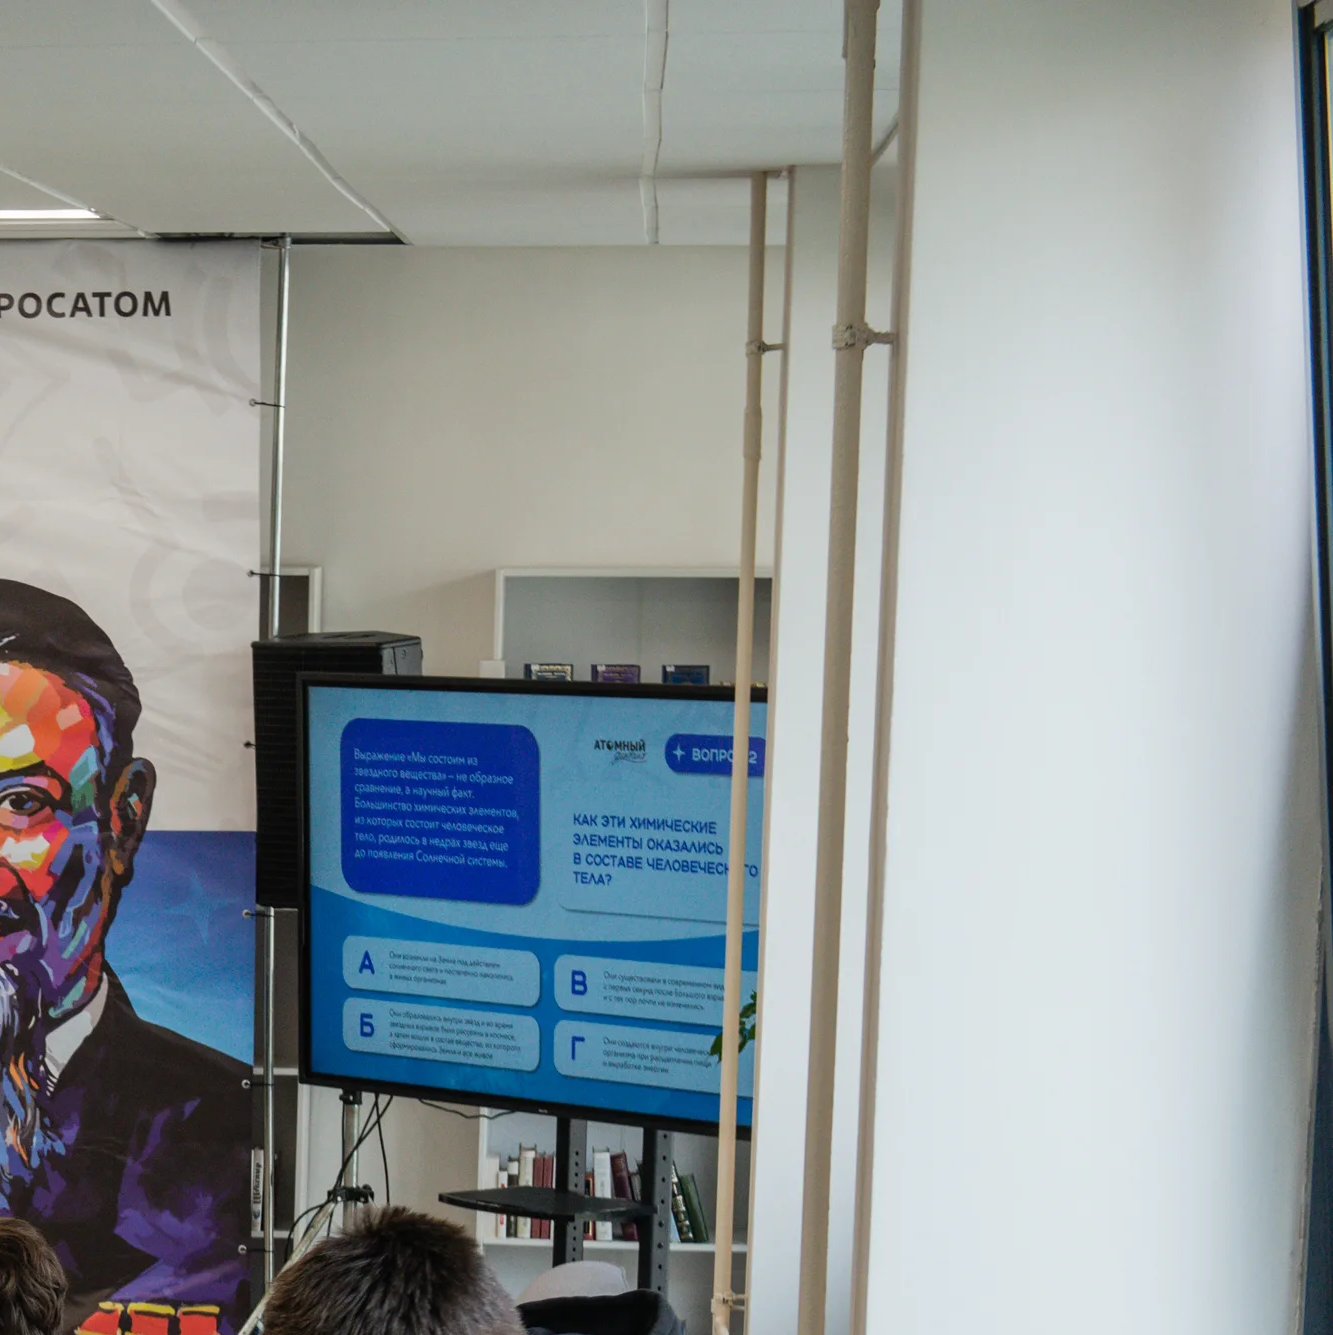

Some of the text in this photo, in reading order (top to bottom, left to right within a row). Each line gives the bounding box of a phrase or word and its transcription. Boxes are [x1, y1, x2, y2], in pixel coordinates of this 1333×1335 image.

[573, 813, 717, 835] КАК ЭТИ ХИМИЧЕСКИЕ
[573, 834, 724, 855] ЭЛЕМЕНТЫ ОКАЗАЛИСЬ
[573, 852, 581, 865] В
[585, 853, 643, 870] СОСТАВЕ
[573, 871, 612, 886] ТЕЛА?
[358, 950, 375, 975] А
[571, 969, 588, 996] В
[359, 1013, 375, 1038] Б
[571, 1036, 586, 1061] Г
